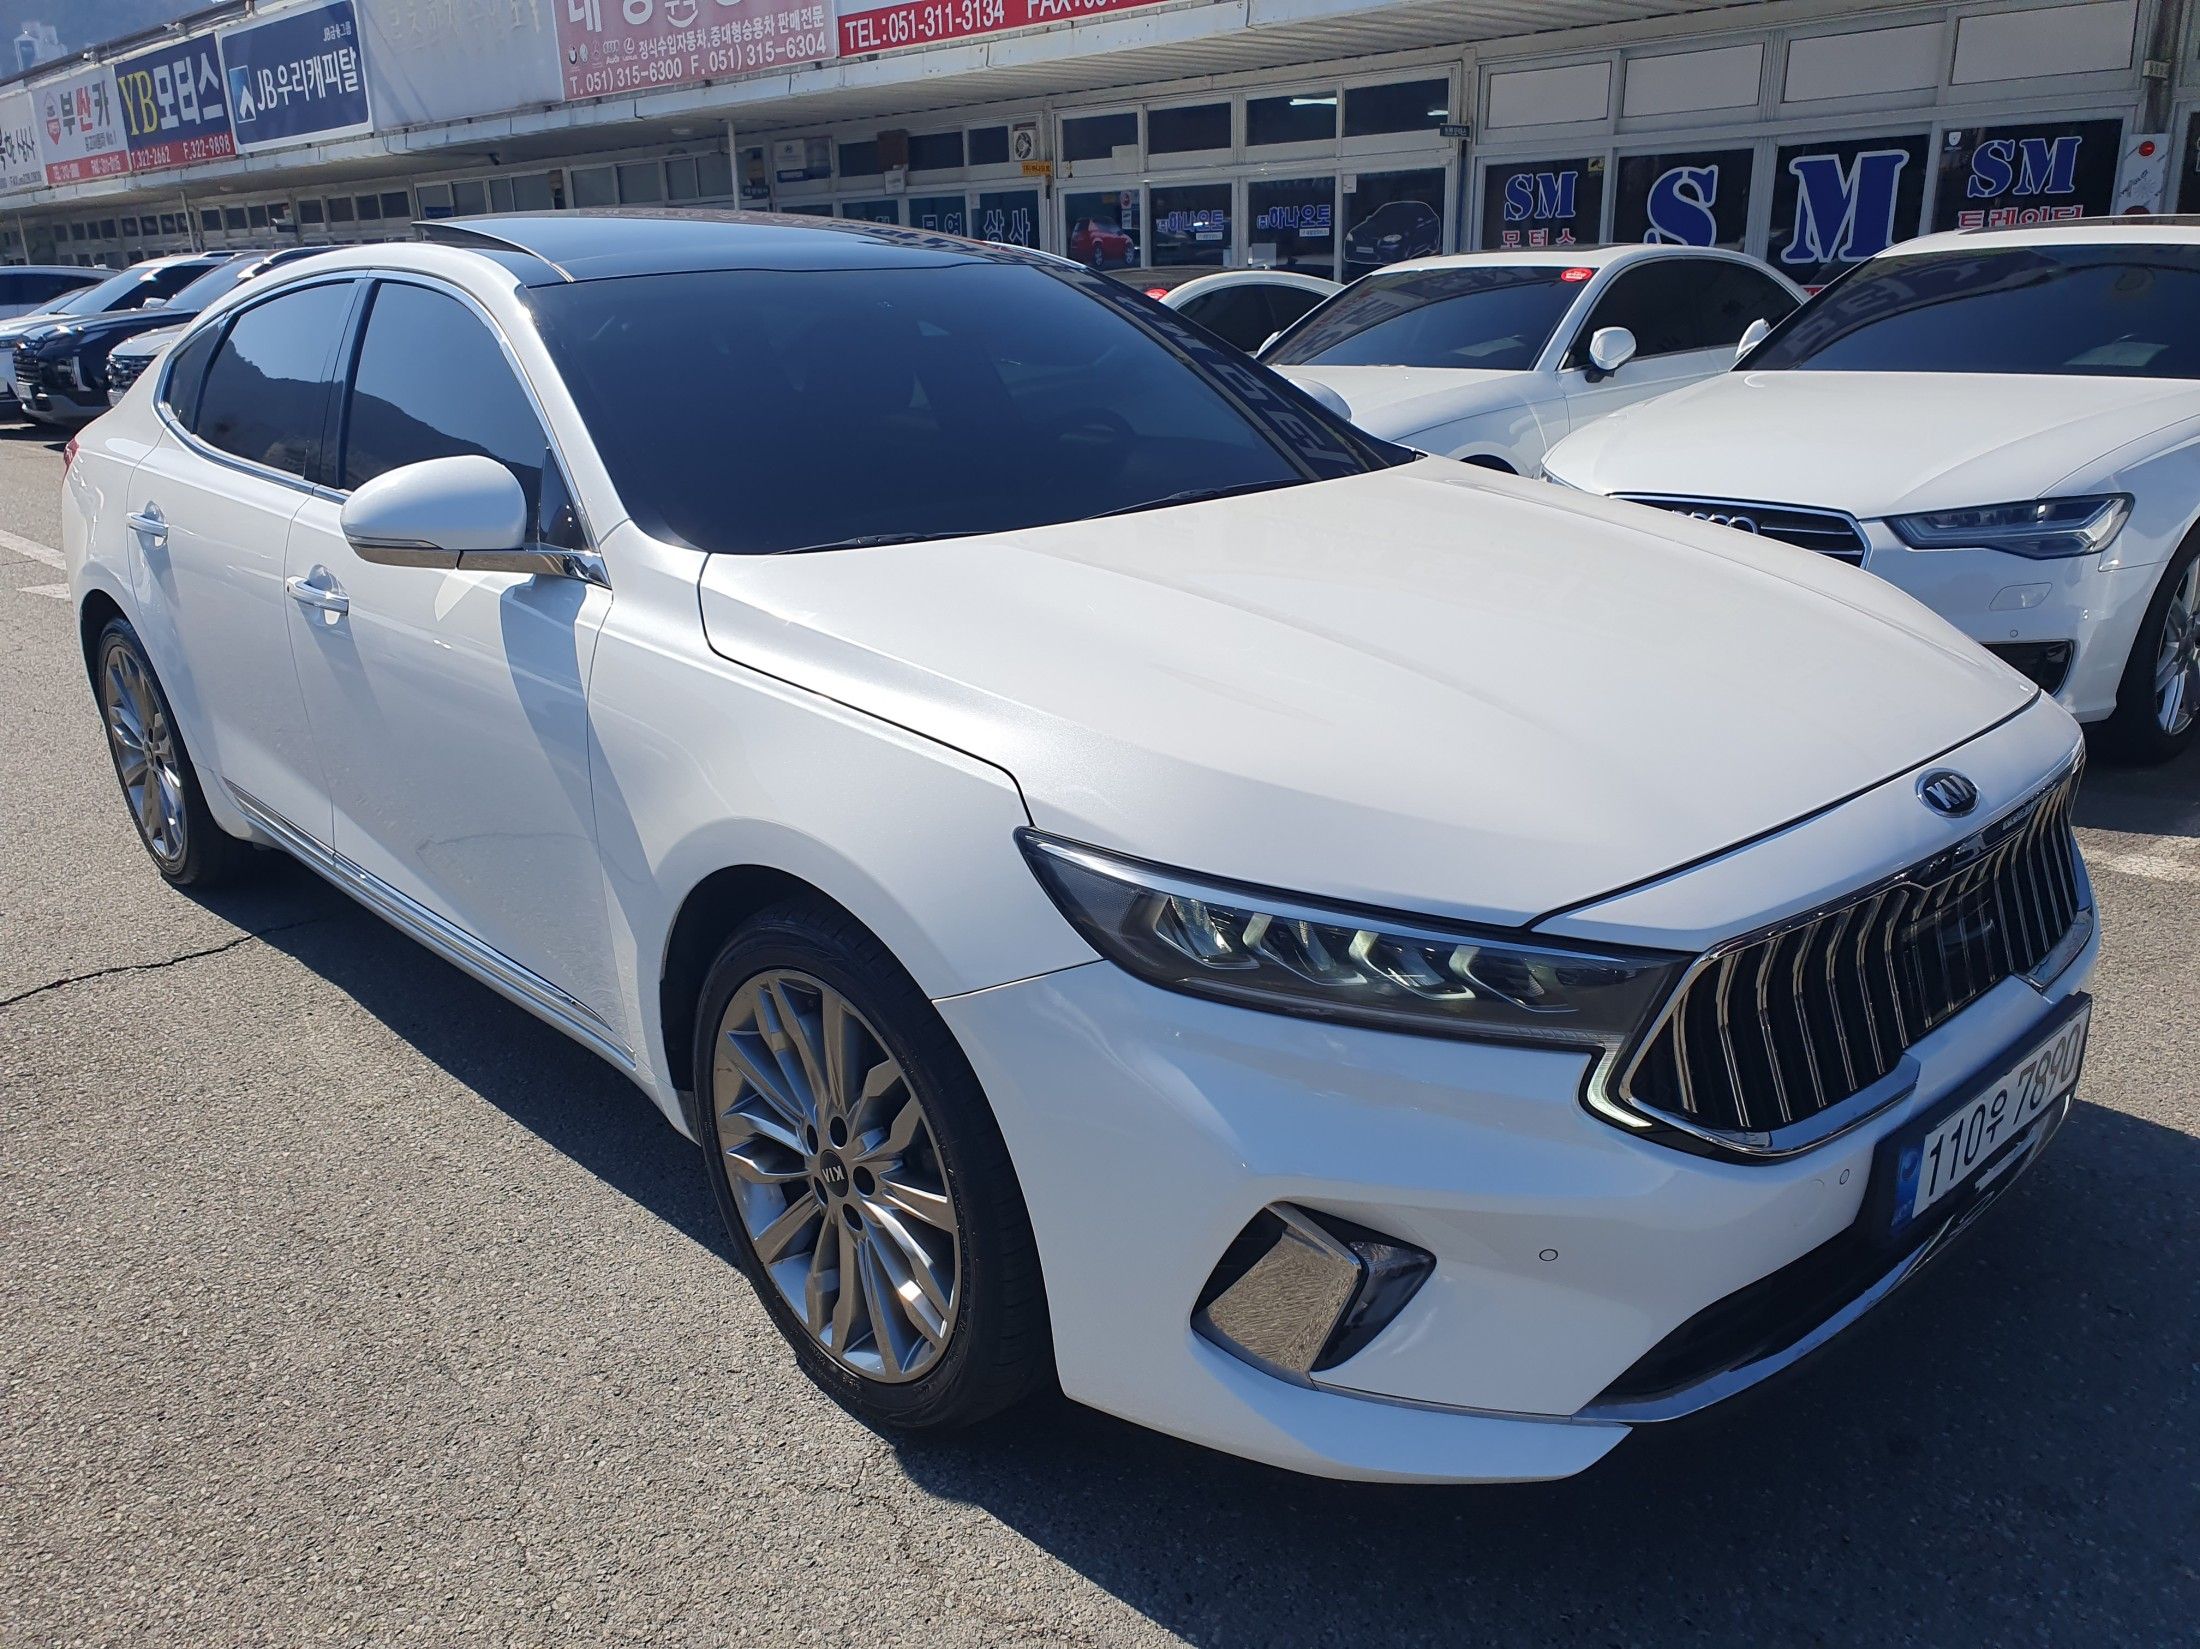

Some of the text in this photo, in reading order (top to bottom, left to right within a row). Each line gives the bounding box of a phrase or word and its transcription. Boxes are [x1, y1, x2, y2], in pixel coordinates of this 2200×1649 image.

[777, 5, 824, 34] 판매전문
[257, 46, 359, 111] JB우리캐피탈
[617, 57, 682, 87] 315-6300
[746, 31, 826, 65] 315-6304
[118, 52, 224, 136] YB모터스
[1504, 171, 1578, 221] SM
[1967, 136, 2083, 198] SM
[1500, 227, 1577, 249] 모터스
[1928, 1023, 2081, 1197] 110우 7890
